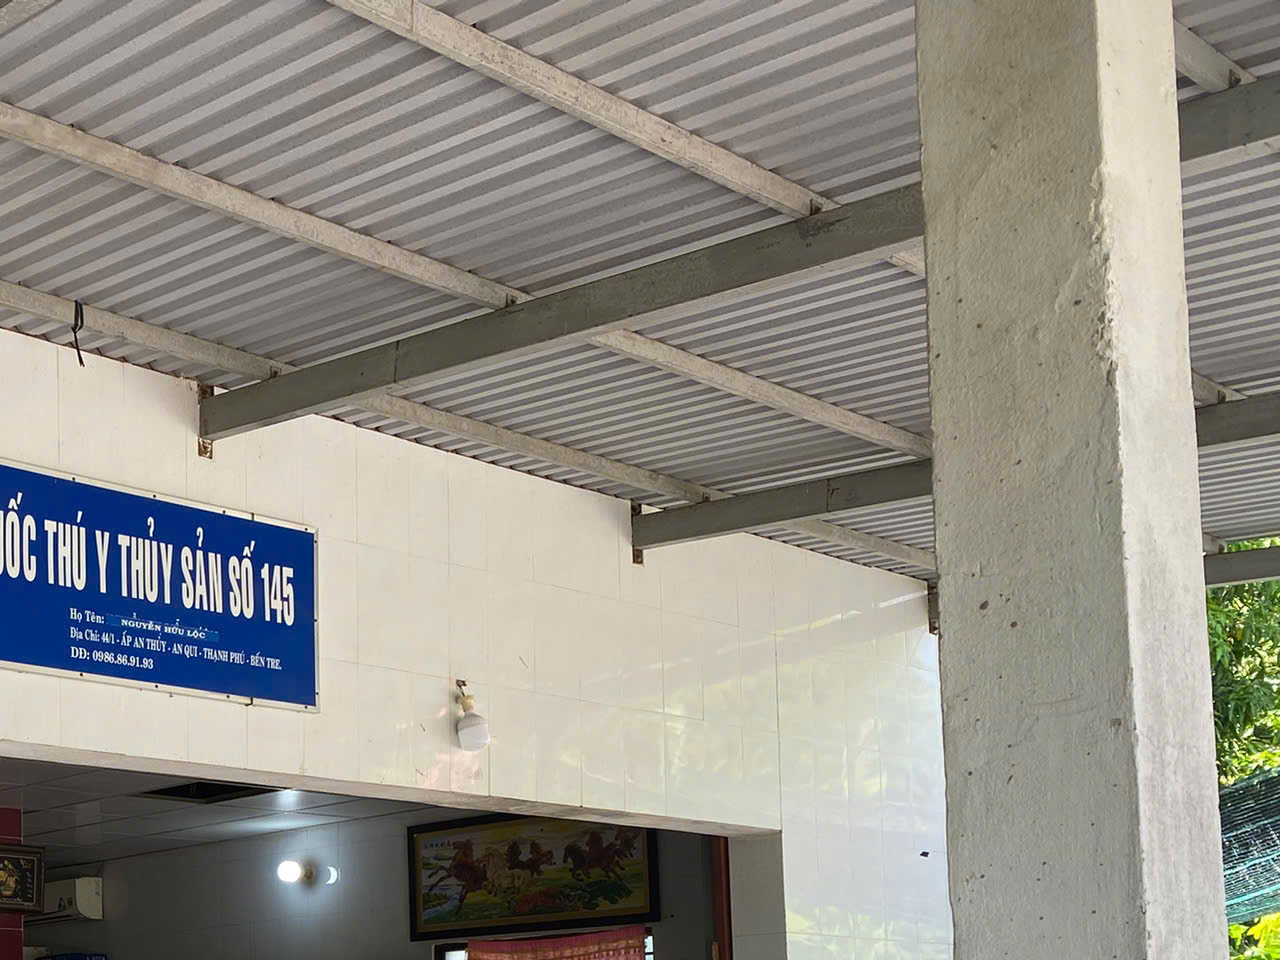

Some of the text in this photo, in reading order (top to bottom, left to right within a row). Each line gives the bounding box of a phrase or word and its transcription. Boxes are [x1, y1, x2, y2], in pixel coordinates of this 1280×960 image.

[44, 511, 86, 591] THÚ
[95, 529, 111, 593] Y
[117, 516, 175, 605] THỦY
[181, 527, 223, 613] SẢN
[228, 541, 255, 619] SỐ
[260, 561, 295, 626] 145
[70, 608, 82, 623] Họ
[85, 610, 105, 624] Tên:
[70, 626, 83, 641] Địa
[101, 632, 115, 645] 44/1
[121, 630, 132, 646] ẤP
[133, 636, 145, 648] AN
[145, 634, 167, 651] THỦY
[172, 643, 183, 655] AN
[184, 645, 198, 658] QUI
[229, 650, 246, 664] PHÚ
[250, 653, 265, 667] BẾN
[70, 646, 154, 669] DĐ: 0986.86.91.93
